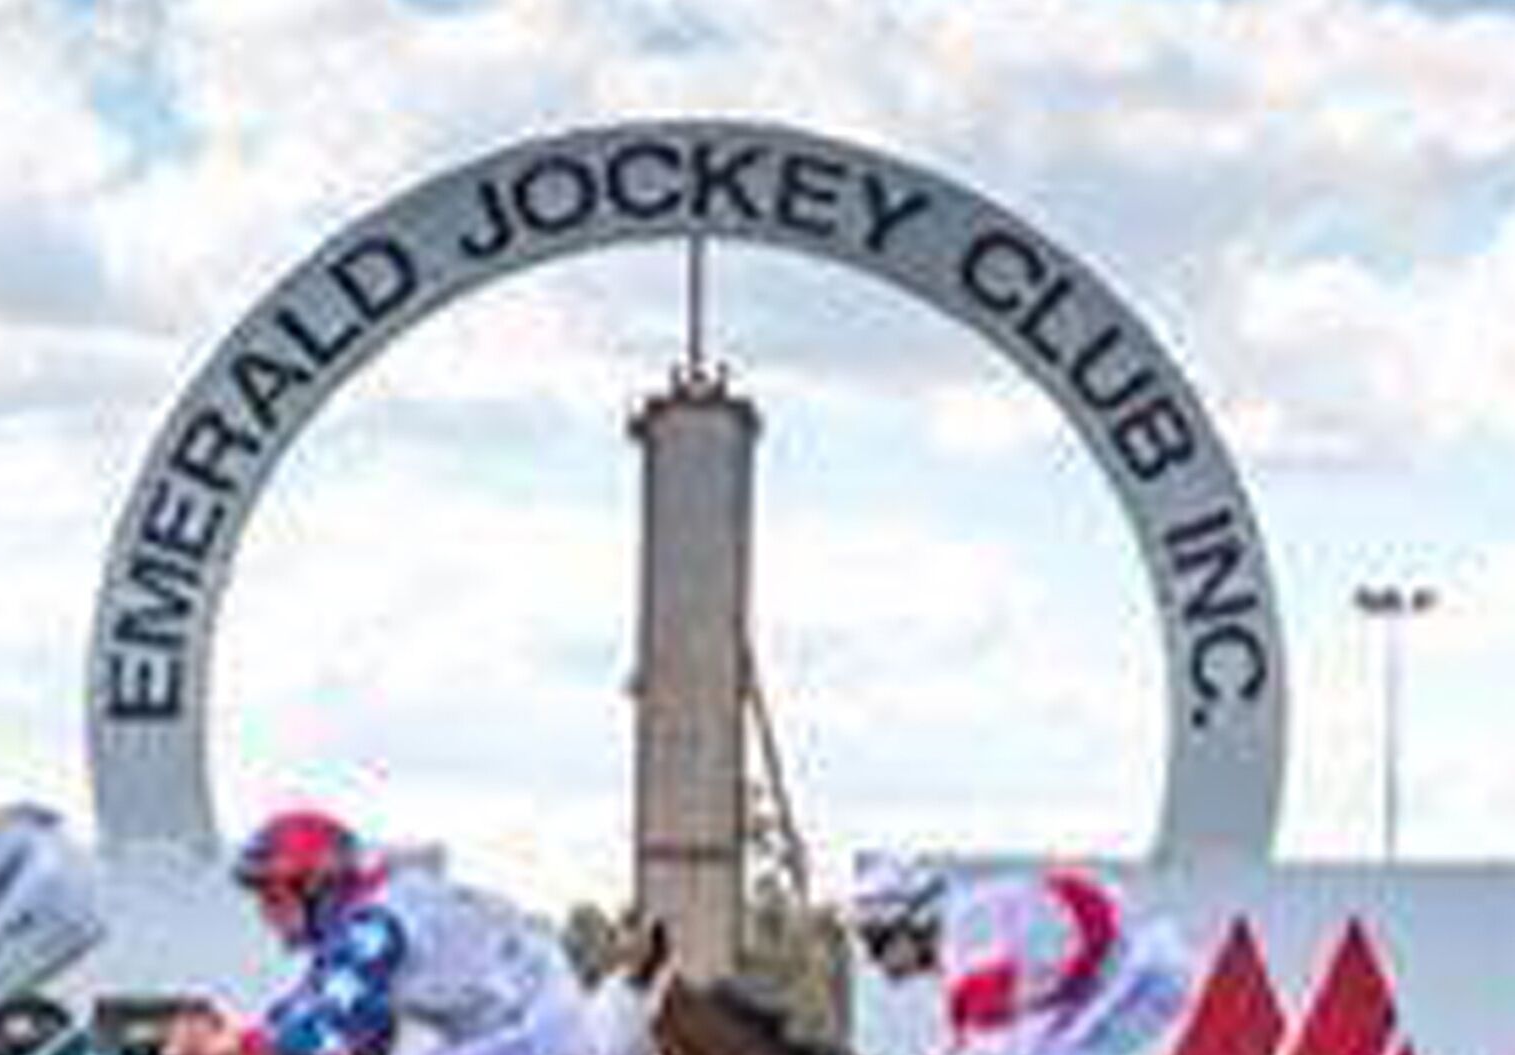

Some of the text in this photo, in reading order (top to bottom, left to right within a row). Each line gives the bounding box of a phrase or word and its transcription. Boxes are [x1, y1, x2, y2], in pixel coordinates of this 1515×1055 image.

[106, 142, 1266, 729] EMERALD JOCKEY CLUB INC.
